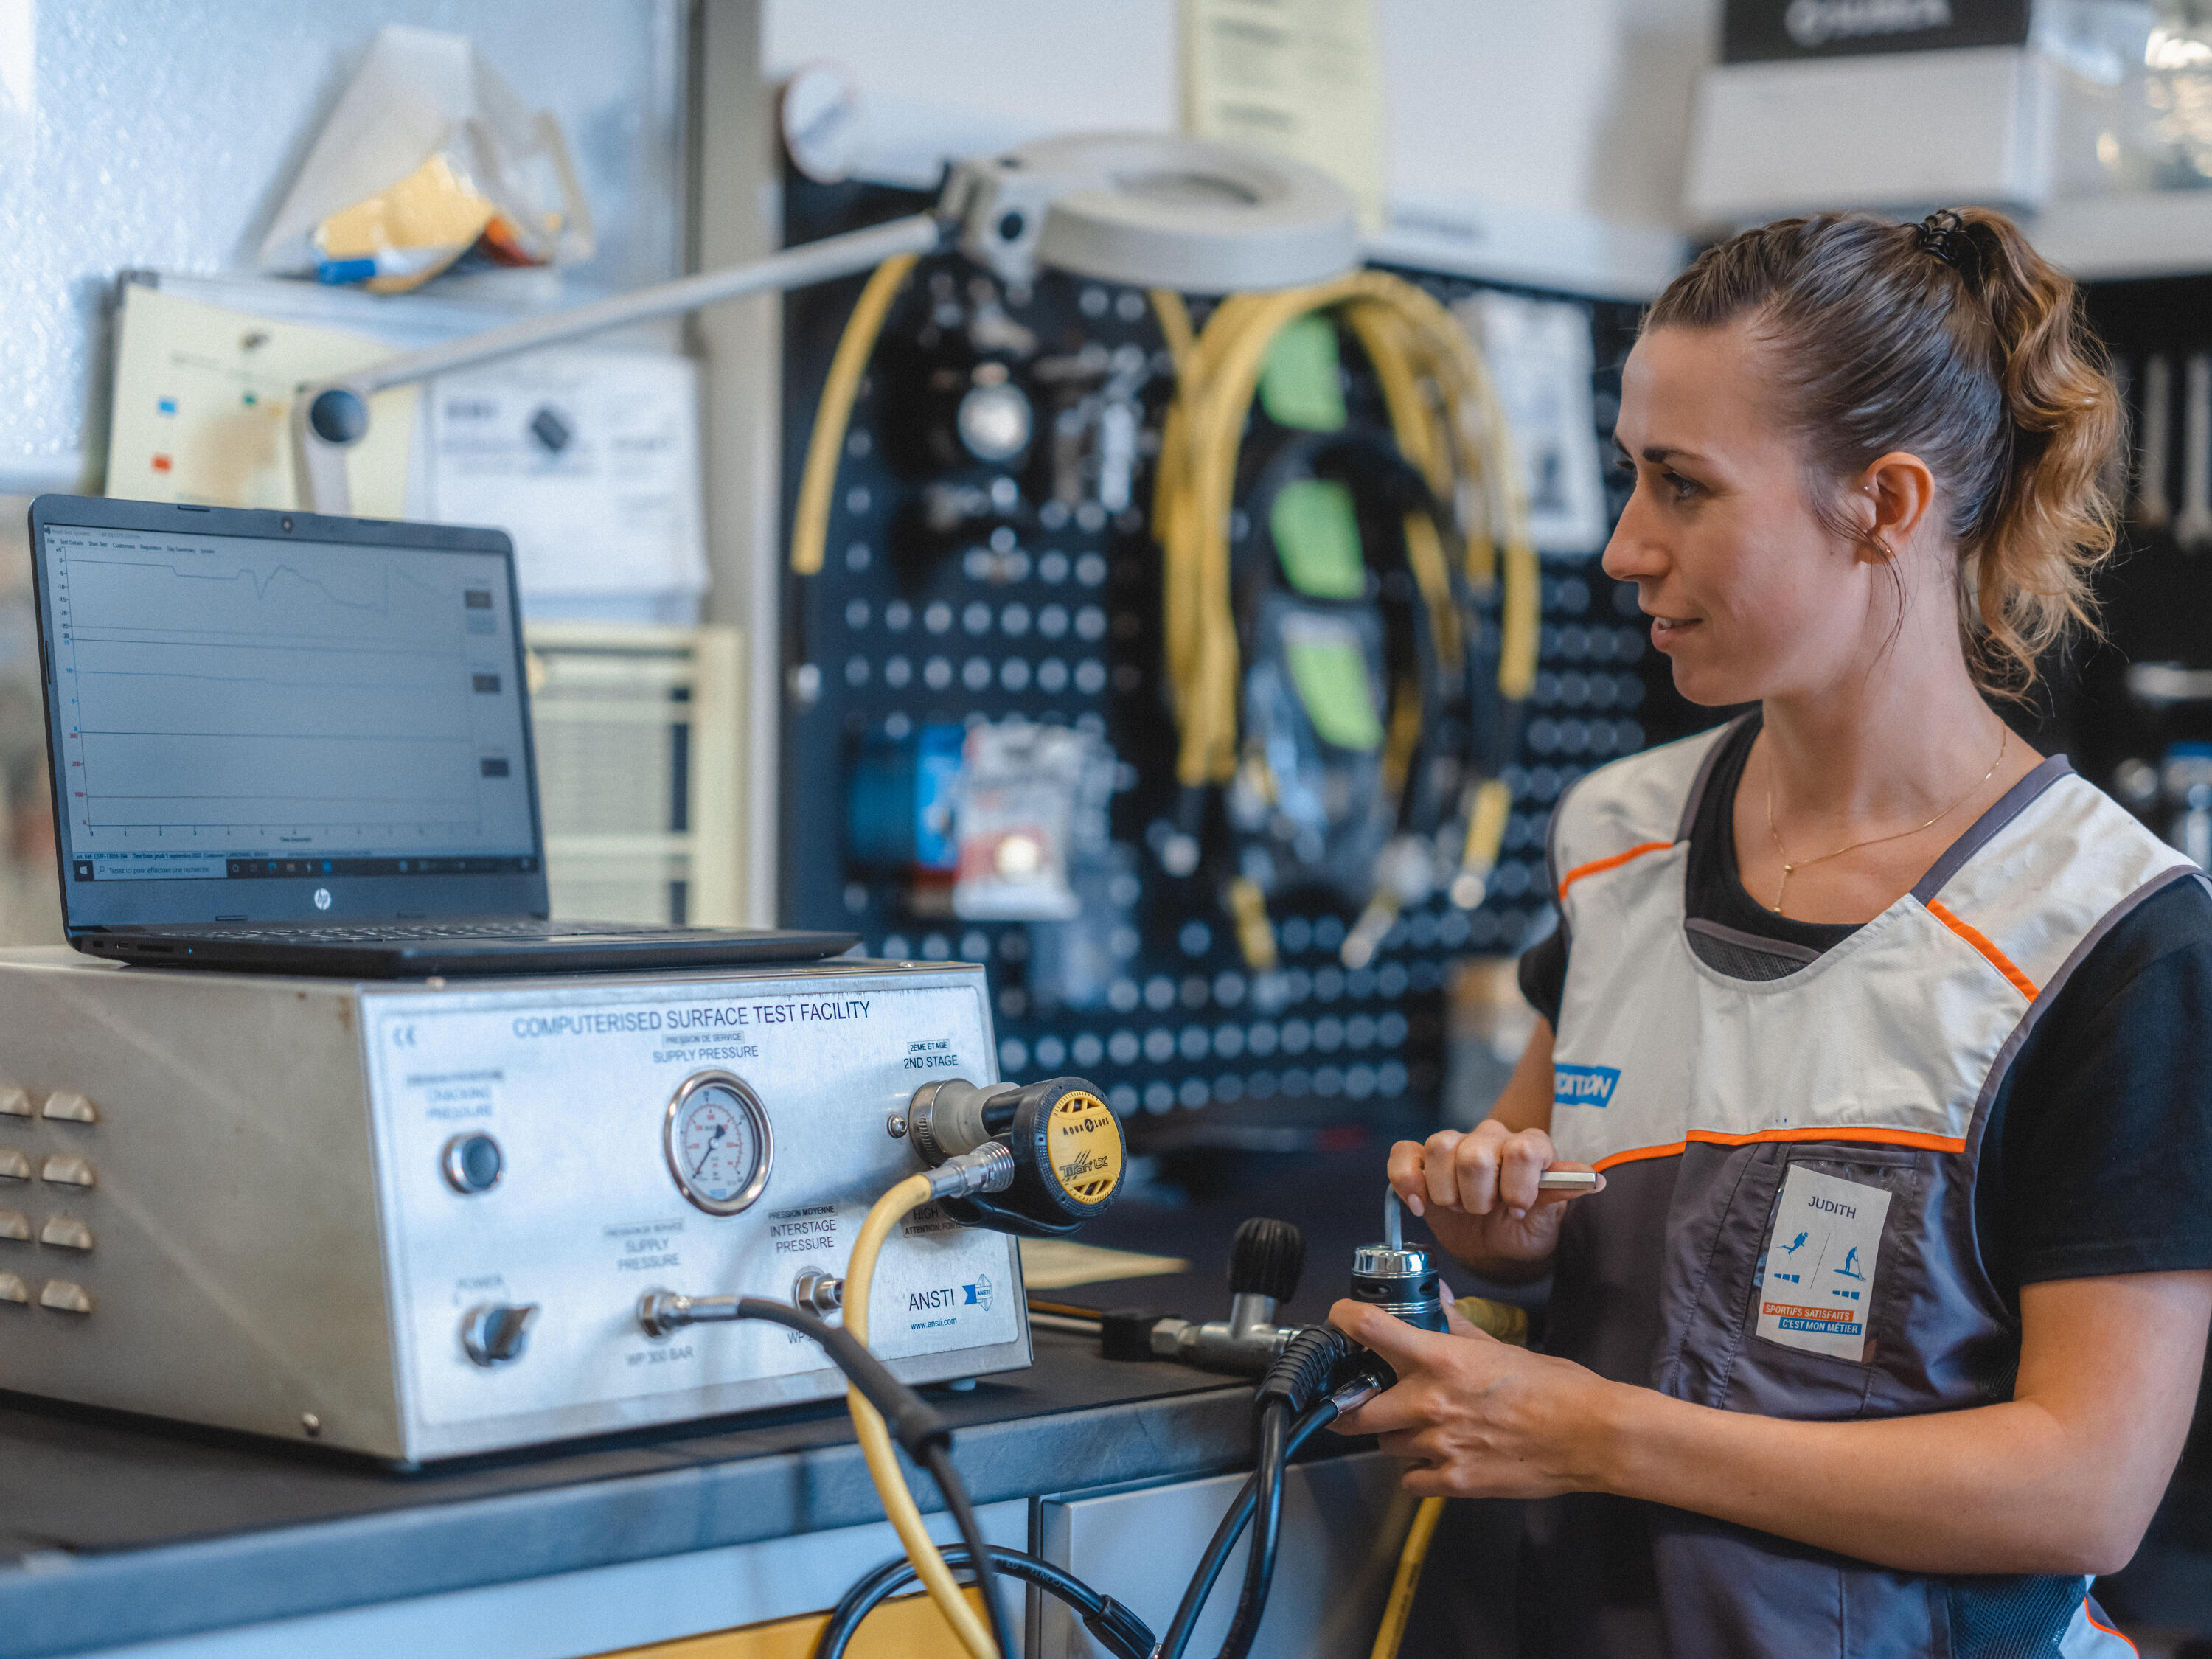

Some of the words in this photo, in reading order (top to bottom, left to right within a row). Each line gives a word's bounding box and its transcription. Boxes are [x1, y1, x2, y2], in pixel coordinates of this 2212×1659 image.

[316, 889, 329, 909] hp
[514, 1011, 661, 1038] COMPUTERISED
[667, 1006, 749, 1029] SURFACE
[753, 1004, 796, 1024] TEST
[801, 1001, 871, 1020] FACILITY
[712, 1032, 742, 1043] SERVICE
[653, 1048, 696, 1063] SUPPLY
[698, 1045, 759, 1060] PRESSURE
[903, 1057, 924, 1069] 2ND
[926, 1054, 959, 1068] STAGE
[1062, 1124, 1085, 1136] AQUA
[1094, 1117, 1110, 1128] LUNG
[768, 1209, 802, 1220] PRESSION
[802, 1205, 835, 1216] MOYENNE
[914, 1207, 939, 1220] HIGH
[1807, 1196, 1857, 1219] JUDITH
[770, 1219, 837, 1237] INTERSTAGE
[776, 1236, 835, 1253] PRESSURE
[908, 1288, 955, 1311] ANSTI
[1765, 1304, 1803, 1317] SPORTIFS
[1804, 1309, 1850, 1321] SATISFAITS
[910, 1317, 957, 1330] www.ansti.com
[1782, 1319, 1805, 1329] C'EST
[1806, 1321, 1825, 1332] MON
[1826, 1321, 1858, 1334] MÉTIER
